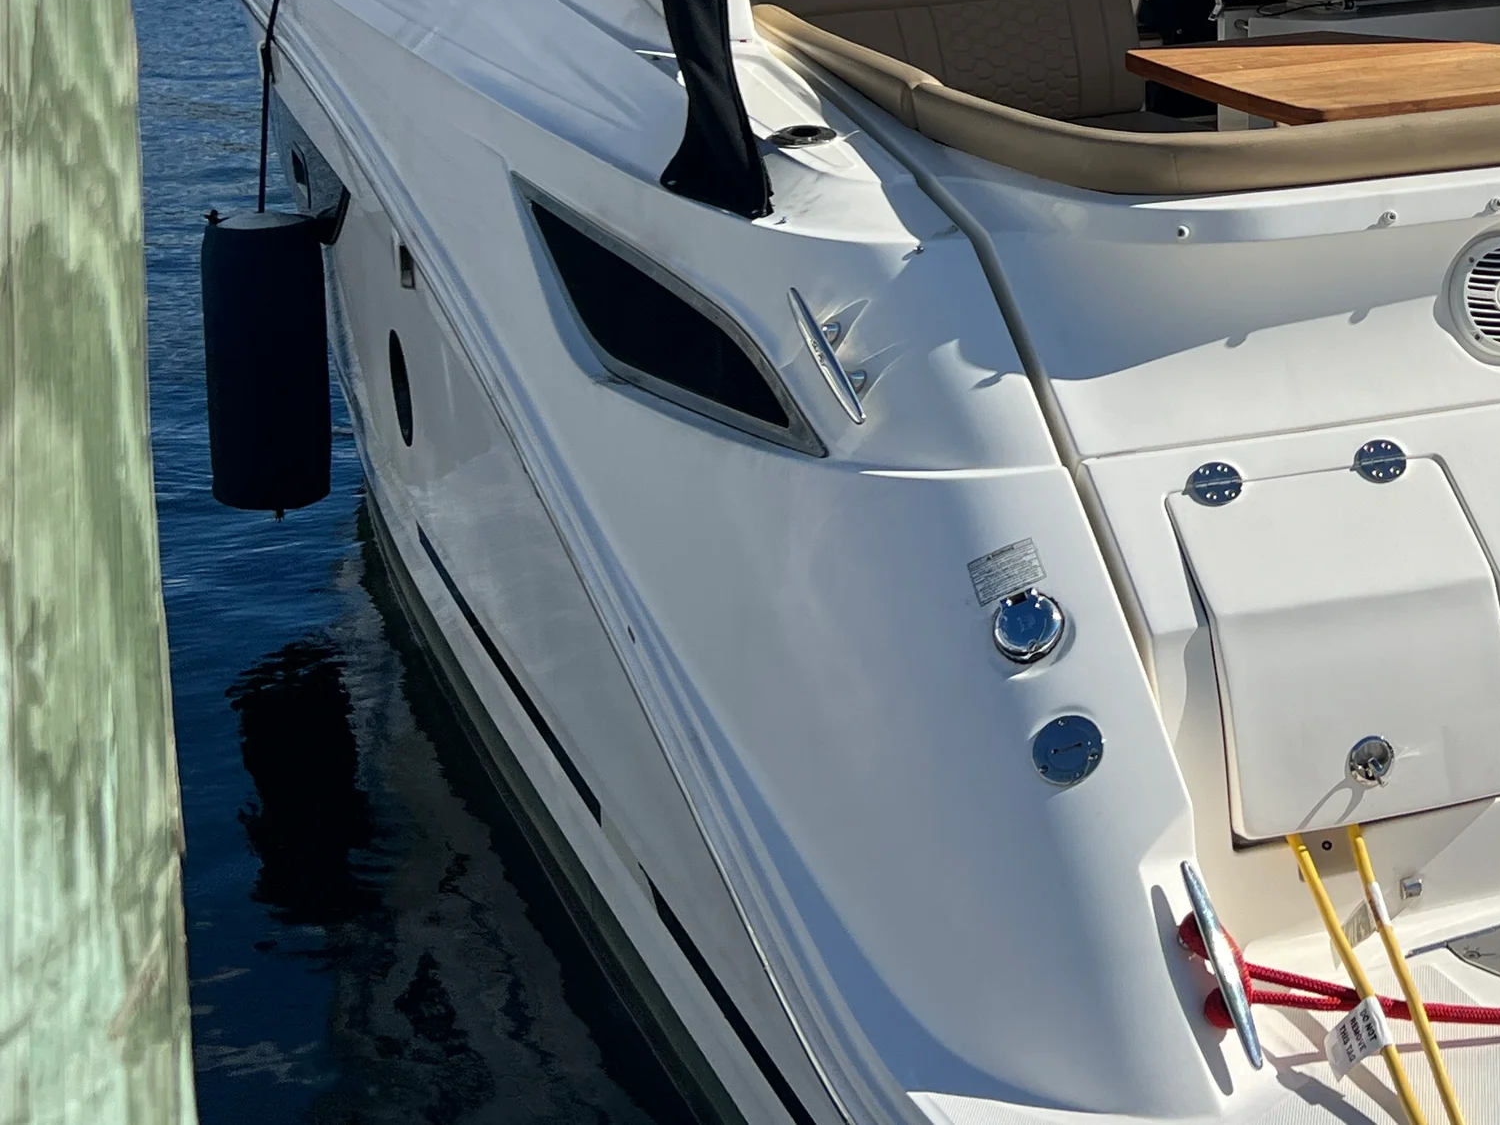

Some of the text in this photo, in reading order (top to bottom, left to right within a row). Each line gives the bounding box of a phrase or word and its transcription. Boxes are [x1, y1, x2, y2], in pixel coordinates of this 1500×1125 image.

[1350, 1016, 1367, 1052] REMOVE
[1360, 1008, 1377, 1041] DO NOT
[1339, 1024, 1356, 1063] THIS TAG
